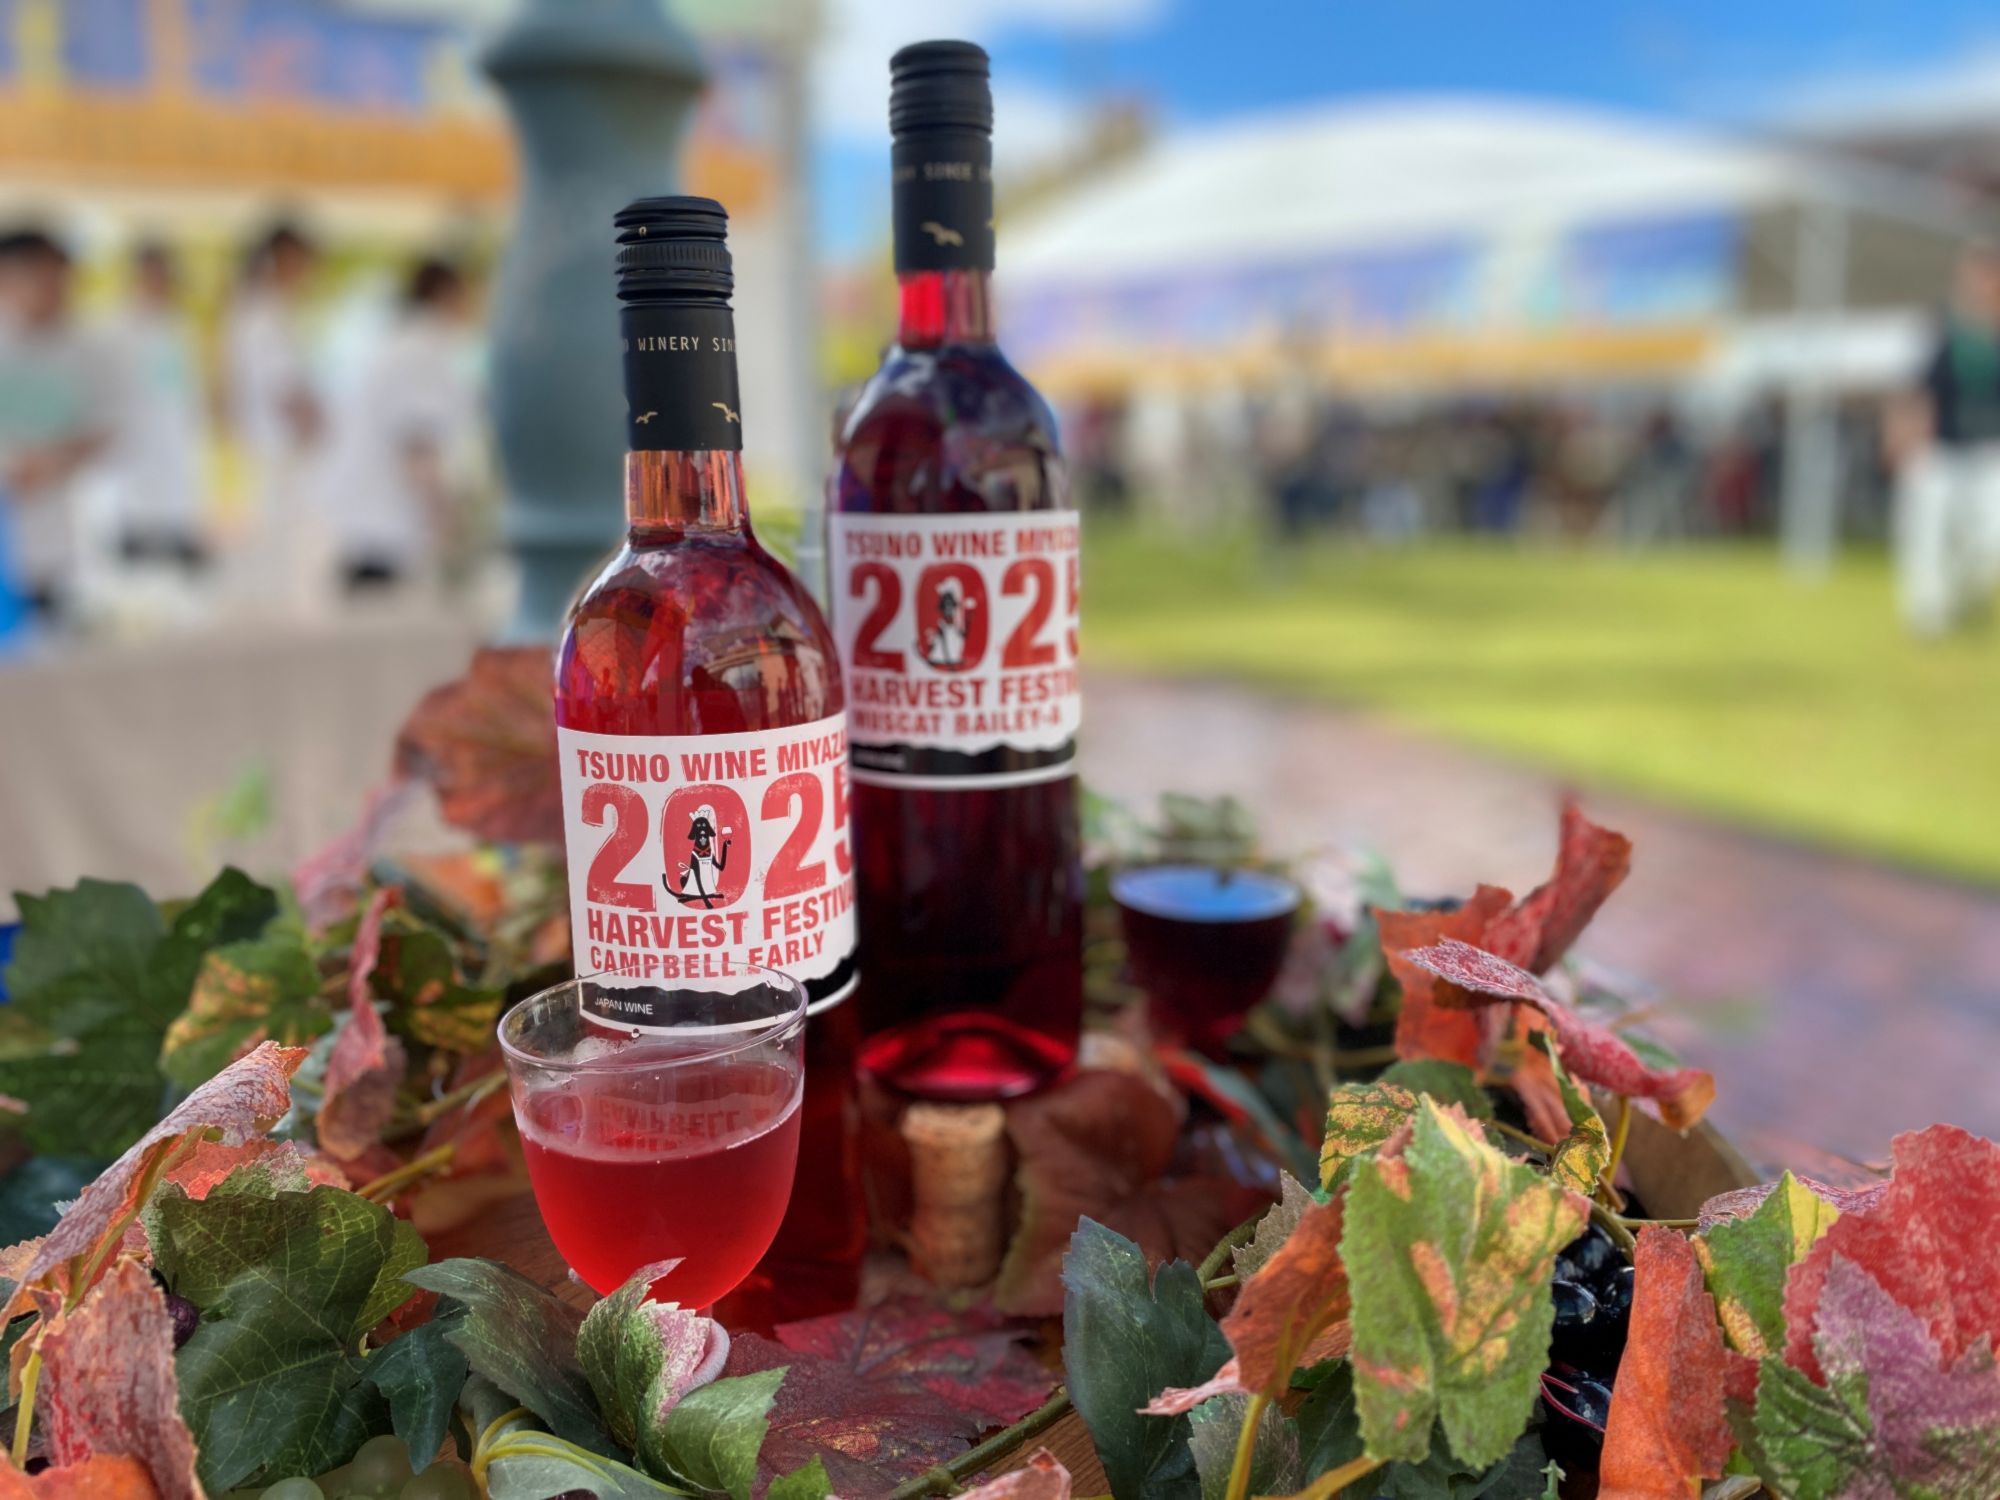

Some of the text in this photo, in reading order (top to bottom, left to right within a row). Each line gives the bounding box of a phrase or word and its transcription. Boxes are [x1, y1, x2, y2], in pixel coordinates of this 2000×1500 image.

[638, 336, 699, 352] WINERY
[712, 337, 736, 352] SIN
[846, 529, 922, 558] TSUNO
[931, 530, 1005, 557] WINE
[853, 670, 987, 709] HARVEST
[853, 709, 941, 735] MUSCAT
[577, 748, 670, 782] TSUNO
[681, 748, 767, 782] WINE
[777, 729, 847, 773] MIYAZ
[587, 908, 749, 949] HARVEST
[590, 930, 825, 979] CAMPBELL EARLY
[594, 997, 654, 1015] JAPAN WINE
